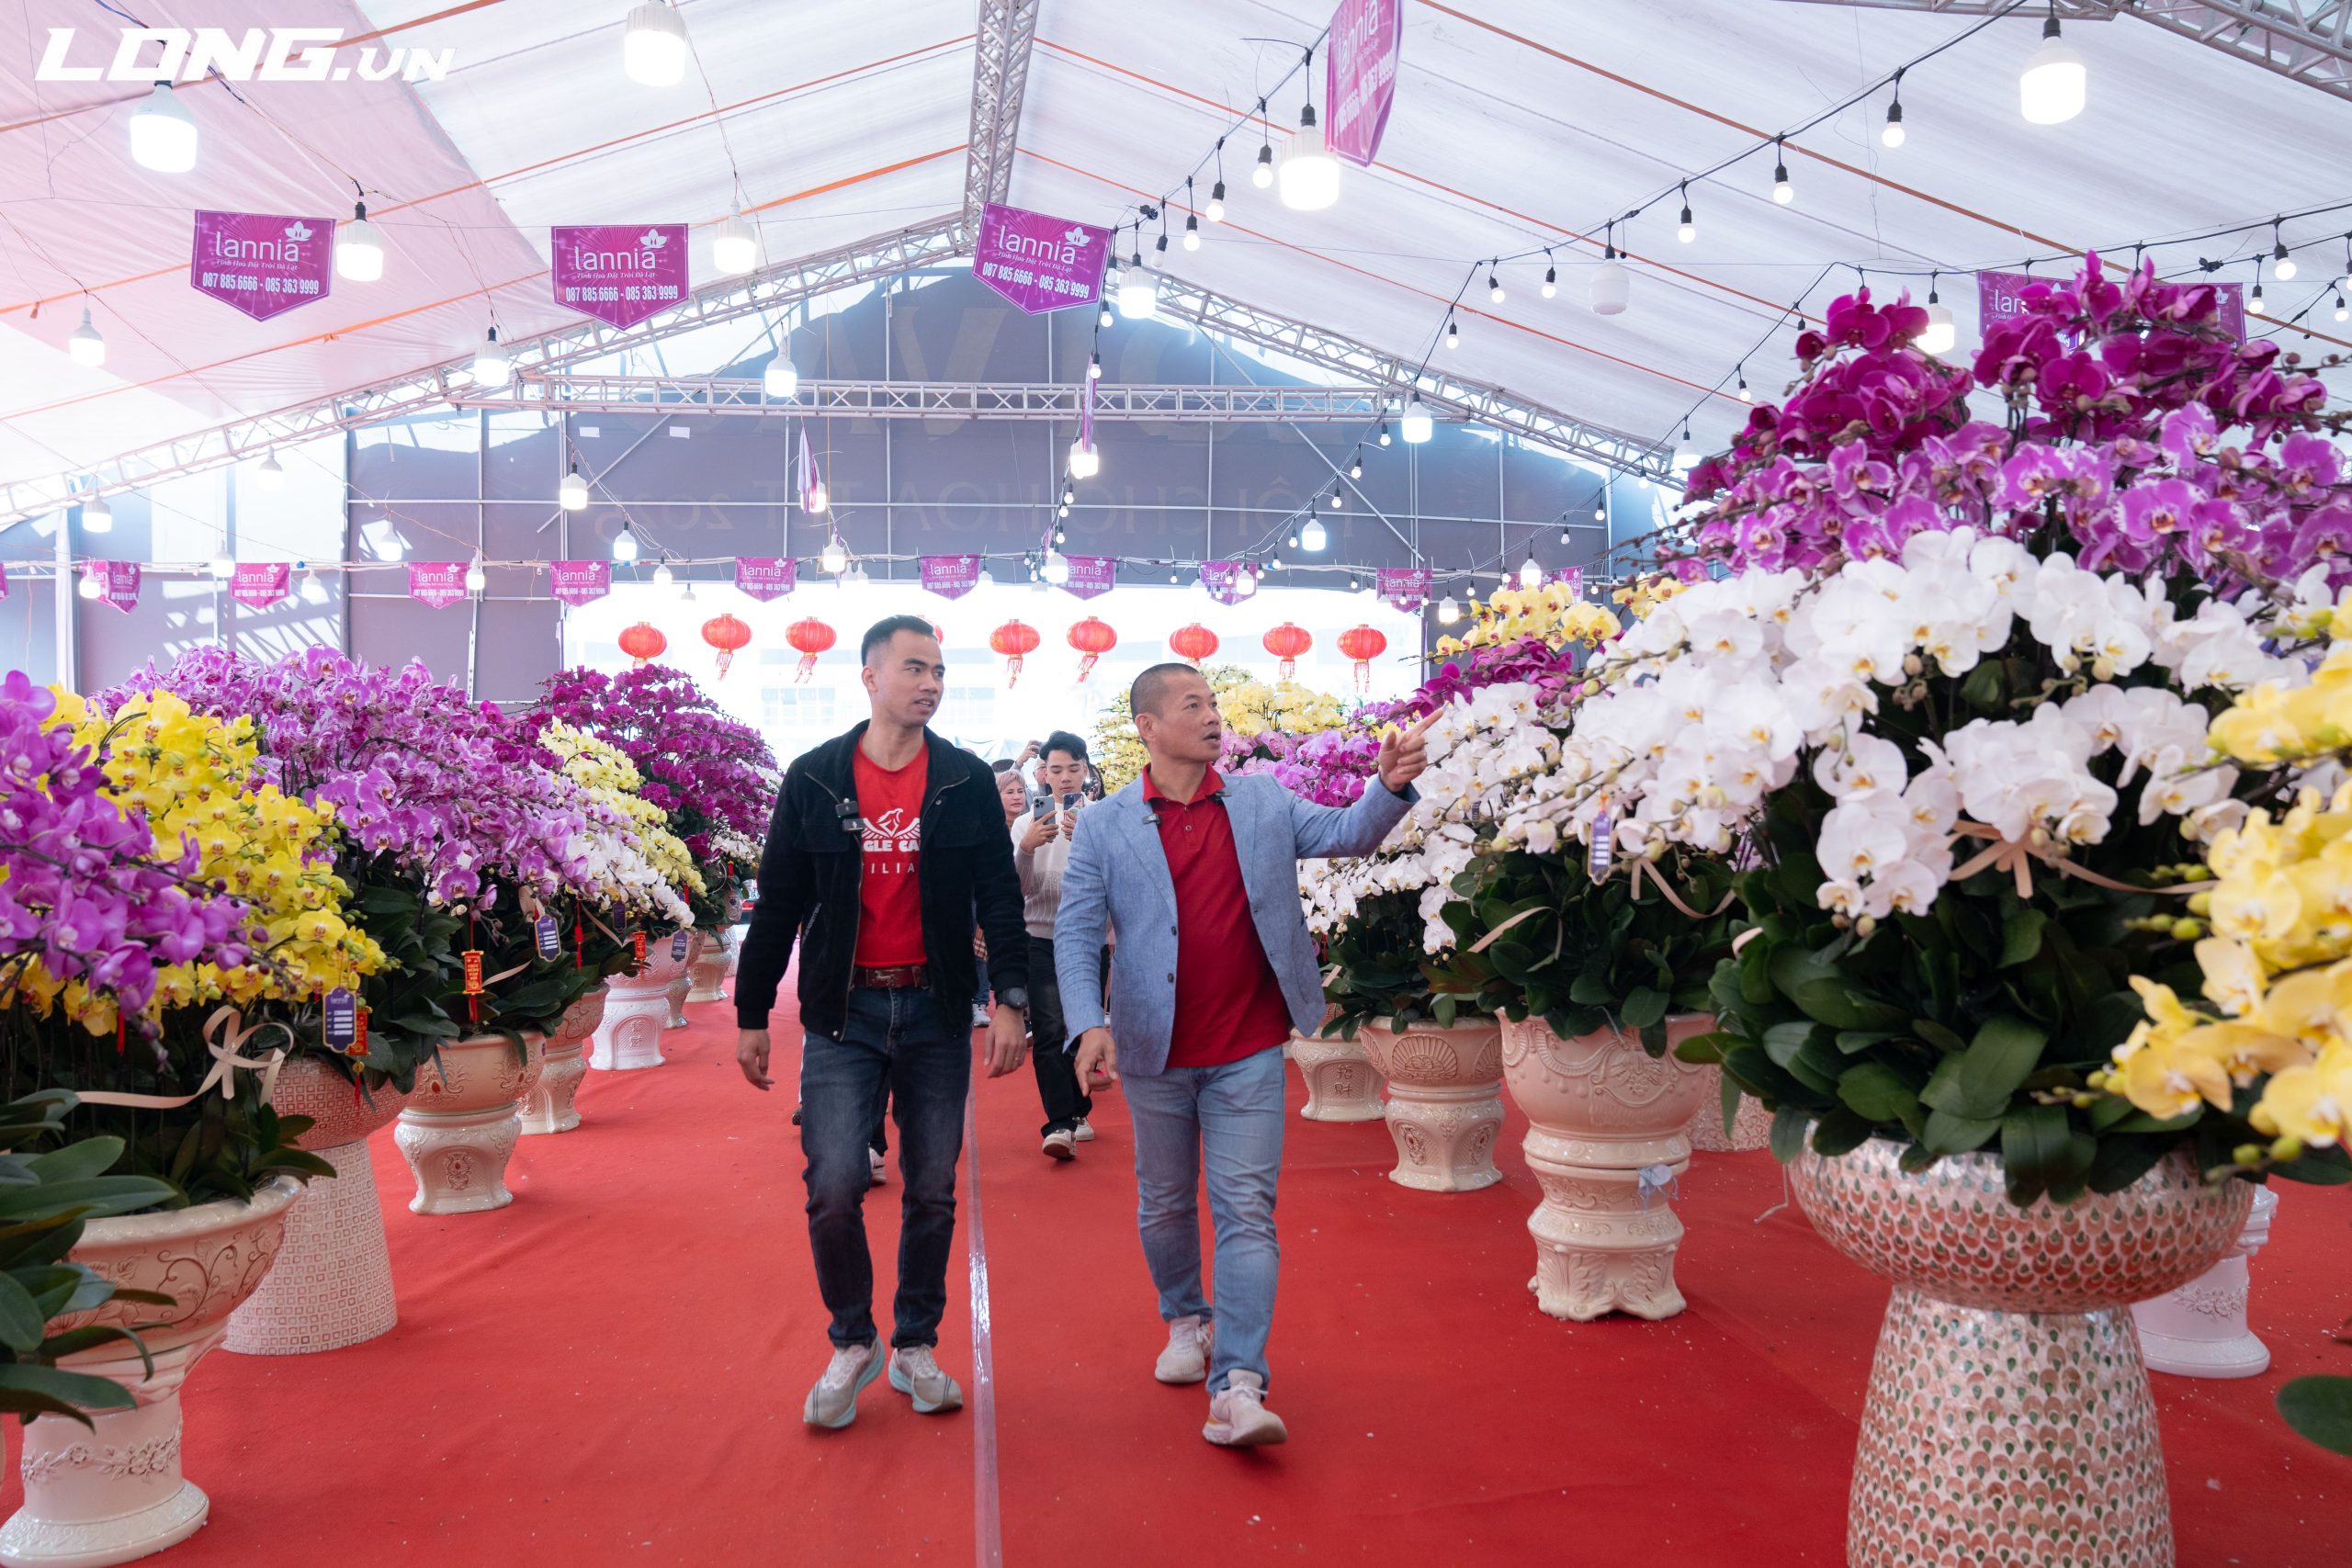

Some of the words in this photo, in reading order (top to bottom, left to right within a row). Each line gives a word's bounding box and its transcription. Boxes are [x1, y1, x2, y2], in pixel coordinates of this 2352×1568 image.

[215, 231, 300, 262] lannia
[999, 225, 1076, 265] lannia
[574, 245, 656, 271] lannia
[202, 272, 217, 288] 087
[220, 273, 235, 289] 885
[237, 275, 258, 291] 6666
[266, 277, 280, 292] 085
[282, 278, 297, 294] 363
[300, 278, 320, 295] 9999
[982, 262, 998, 278] 087
[999, 265, 1013, 281] 885
[1014, 268, 1034, 286] 6666
[1039, 275, 1054, 290] 085
[1056, 278, 1069, 295] 363
[1070, 281, 1091, 299] 9999
[565, 287, 581, 302] 087
[582, 287, 597, 302] 885
[599, 286, 618, 302] 6666
[626, 286, 640, 301] 085
[642, 285, 657, 301] 363
[659, 285, 678, 300] 9999
[418, 570, 454, 582] lannia
[559, 569, 595, 582] lannia
[744, 564, 781, 577] lannia
[931, 563, 967, 576] lannia
[1069, 564, 1102, 576] annia
[238, 570, 274, 583] lannia
[862, 840, 893, 852] GLE
[862, 863, 915, 874] ILIA
